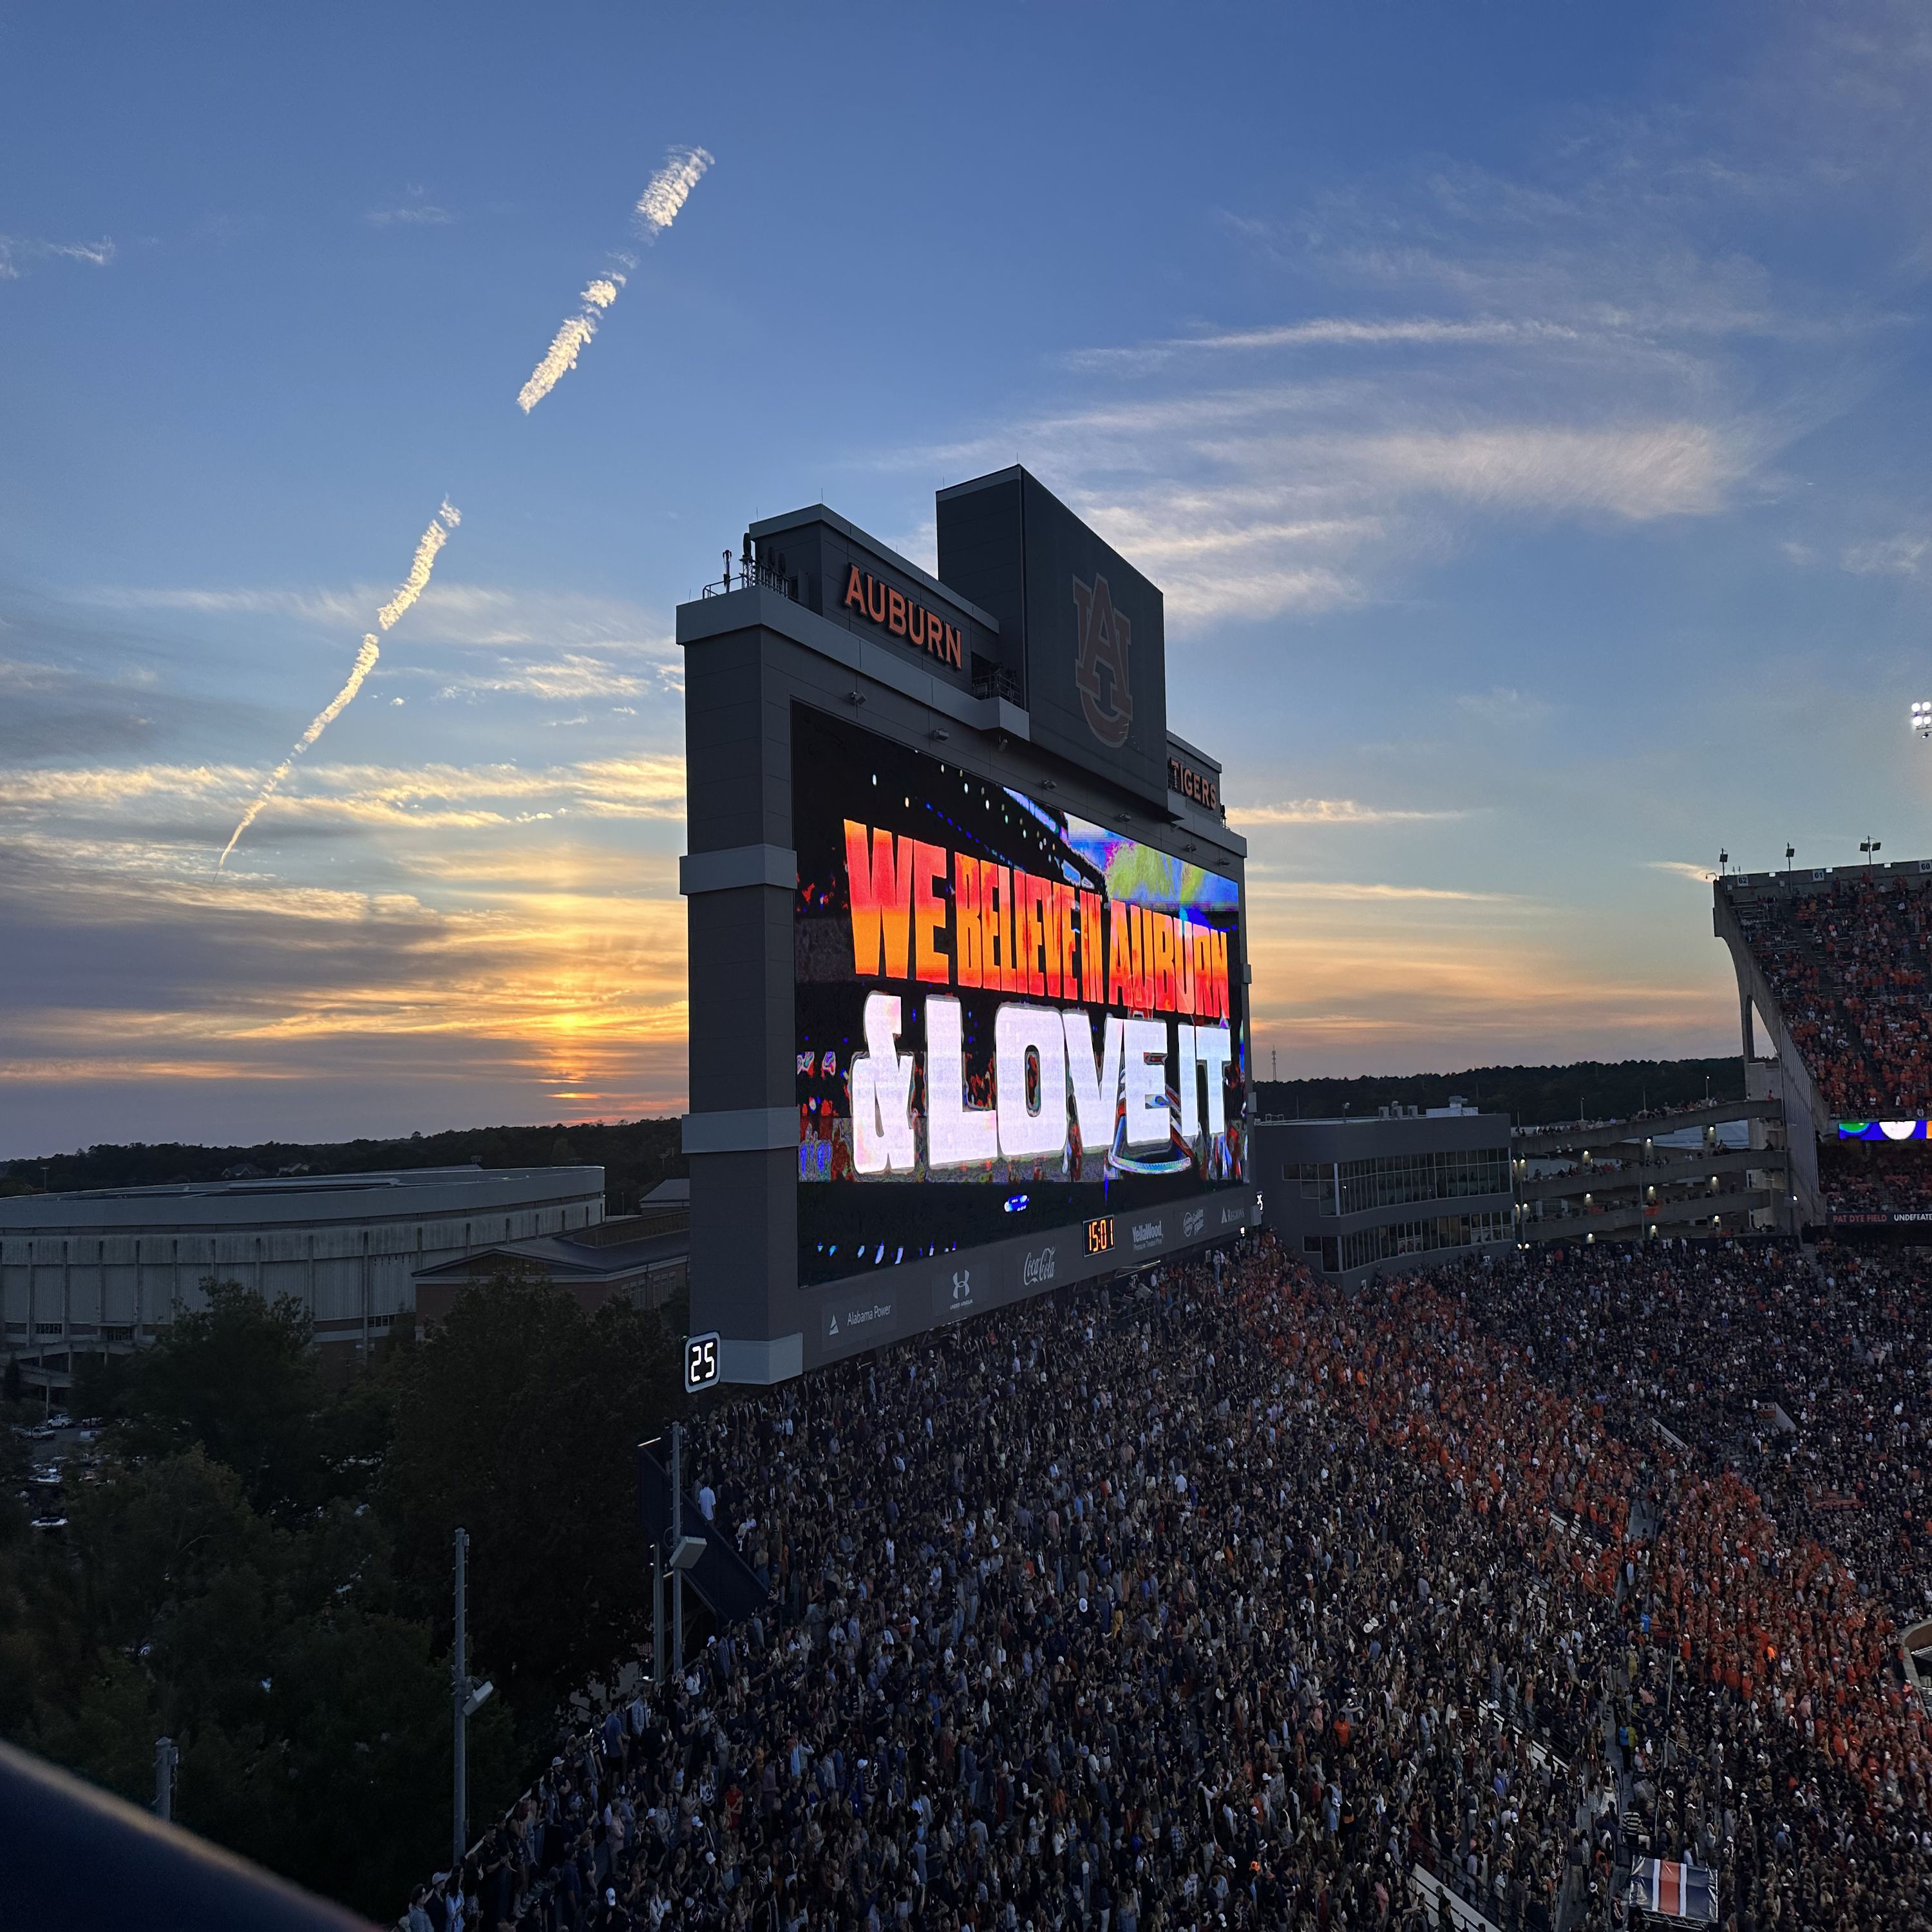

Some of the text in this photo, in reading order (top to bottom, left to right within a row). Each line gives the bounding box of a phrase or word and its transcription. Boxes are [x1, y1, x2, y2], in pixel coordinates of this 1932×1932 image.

[844, 564, 962, 669] AUBURN
[1170, 759, 1217, 810] TIGERS
[844, 819, 1230, 1019] WE BELIEVE IN AUBURN
[853, 992, 1231, 1173] & LOVE IT
[1088, 1218, 1114, 1253] 15:01
[1833, 1215, 1847, 1223] PAT
[1867, 1214, 1888, 1222] FIELD
[847, 1305, 891, 1327] Alabama Power
[690, 1341, 715, 1383] 25
